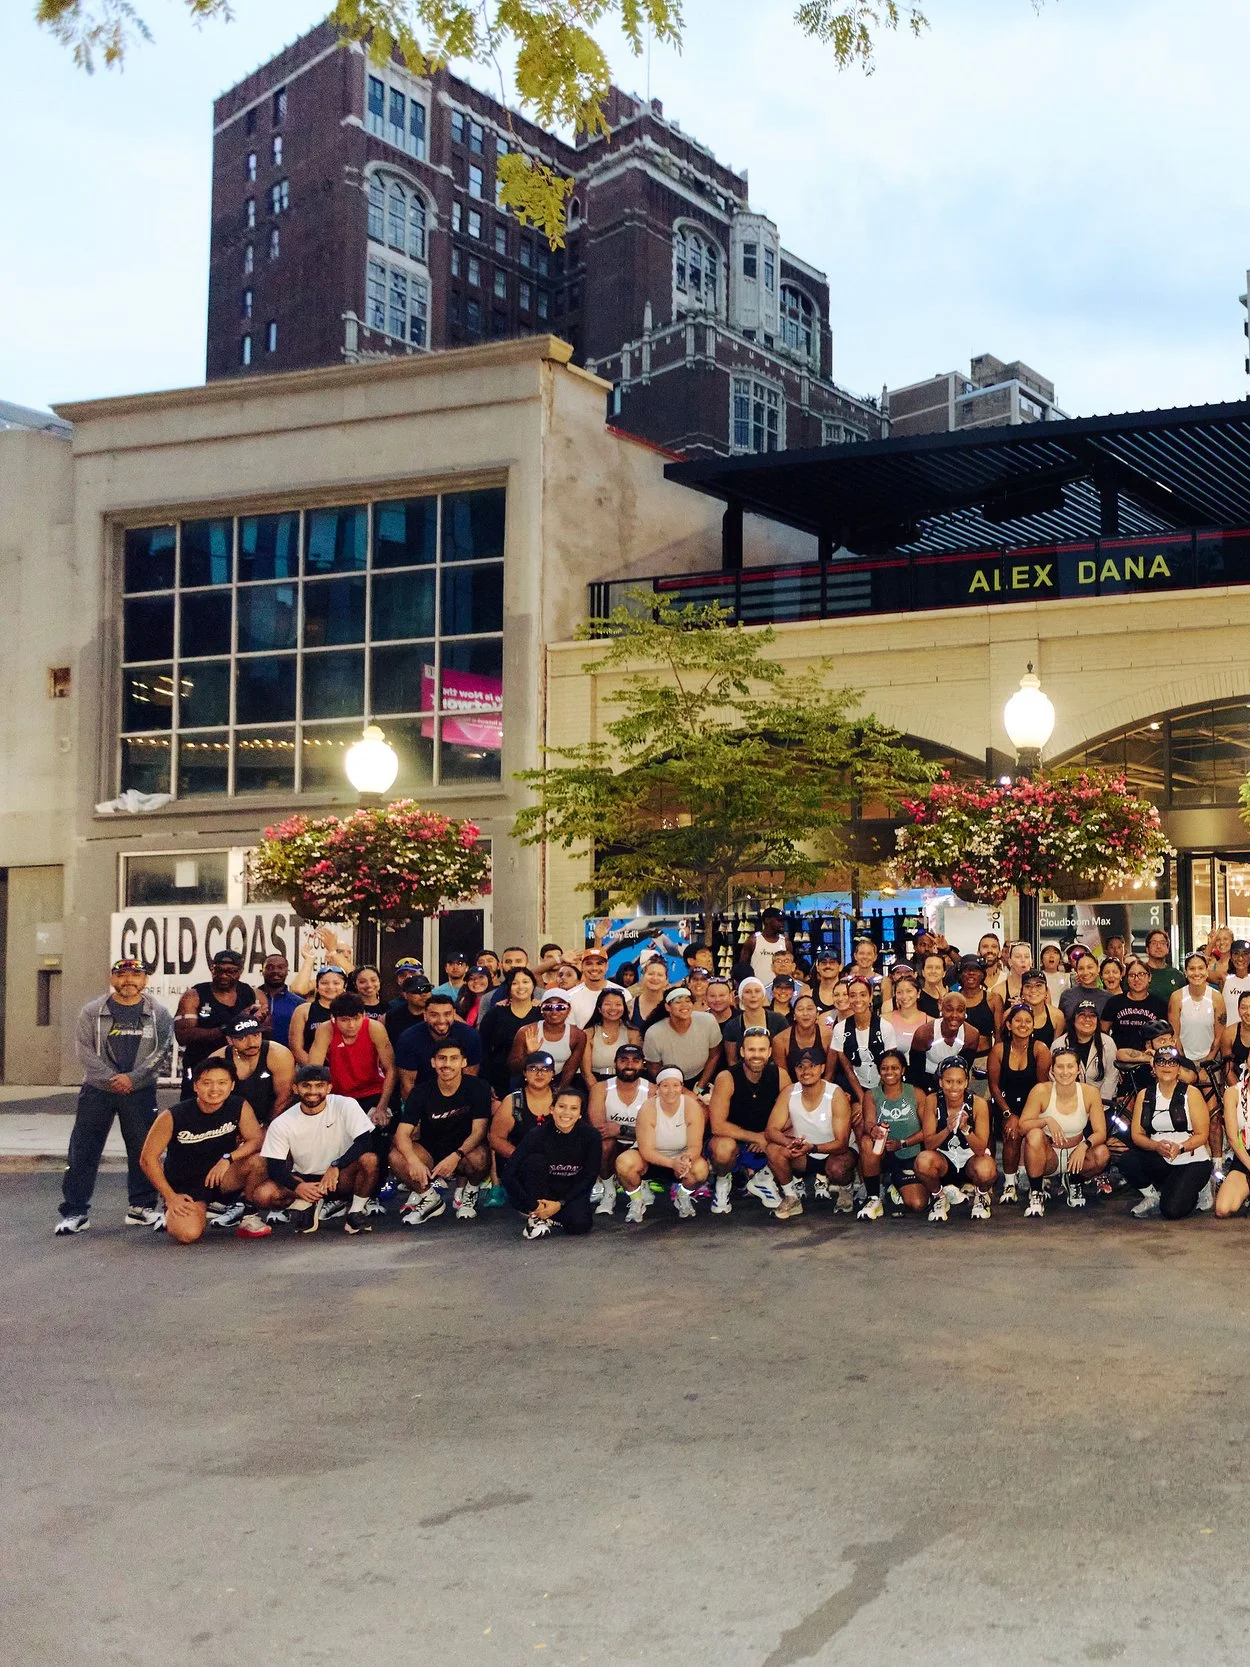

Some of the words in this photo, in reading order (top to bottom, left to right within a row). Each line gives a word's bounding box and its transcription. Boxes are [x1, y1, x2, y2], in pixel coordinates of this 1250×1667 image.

[968, 564, 1053, 593] ALEX
[1078, 555, 1171, 585] DANA
[1040, 909, 1056, 918] The
[1039, 917, 1090, 927] Cloudboom
[1092, 917, 1112, 926] Max
[624, 929, 639, 939] Edit
[121, 917, 198, 975] GOLD
[205, 913, 304, 974] COAST
